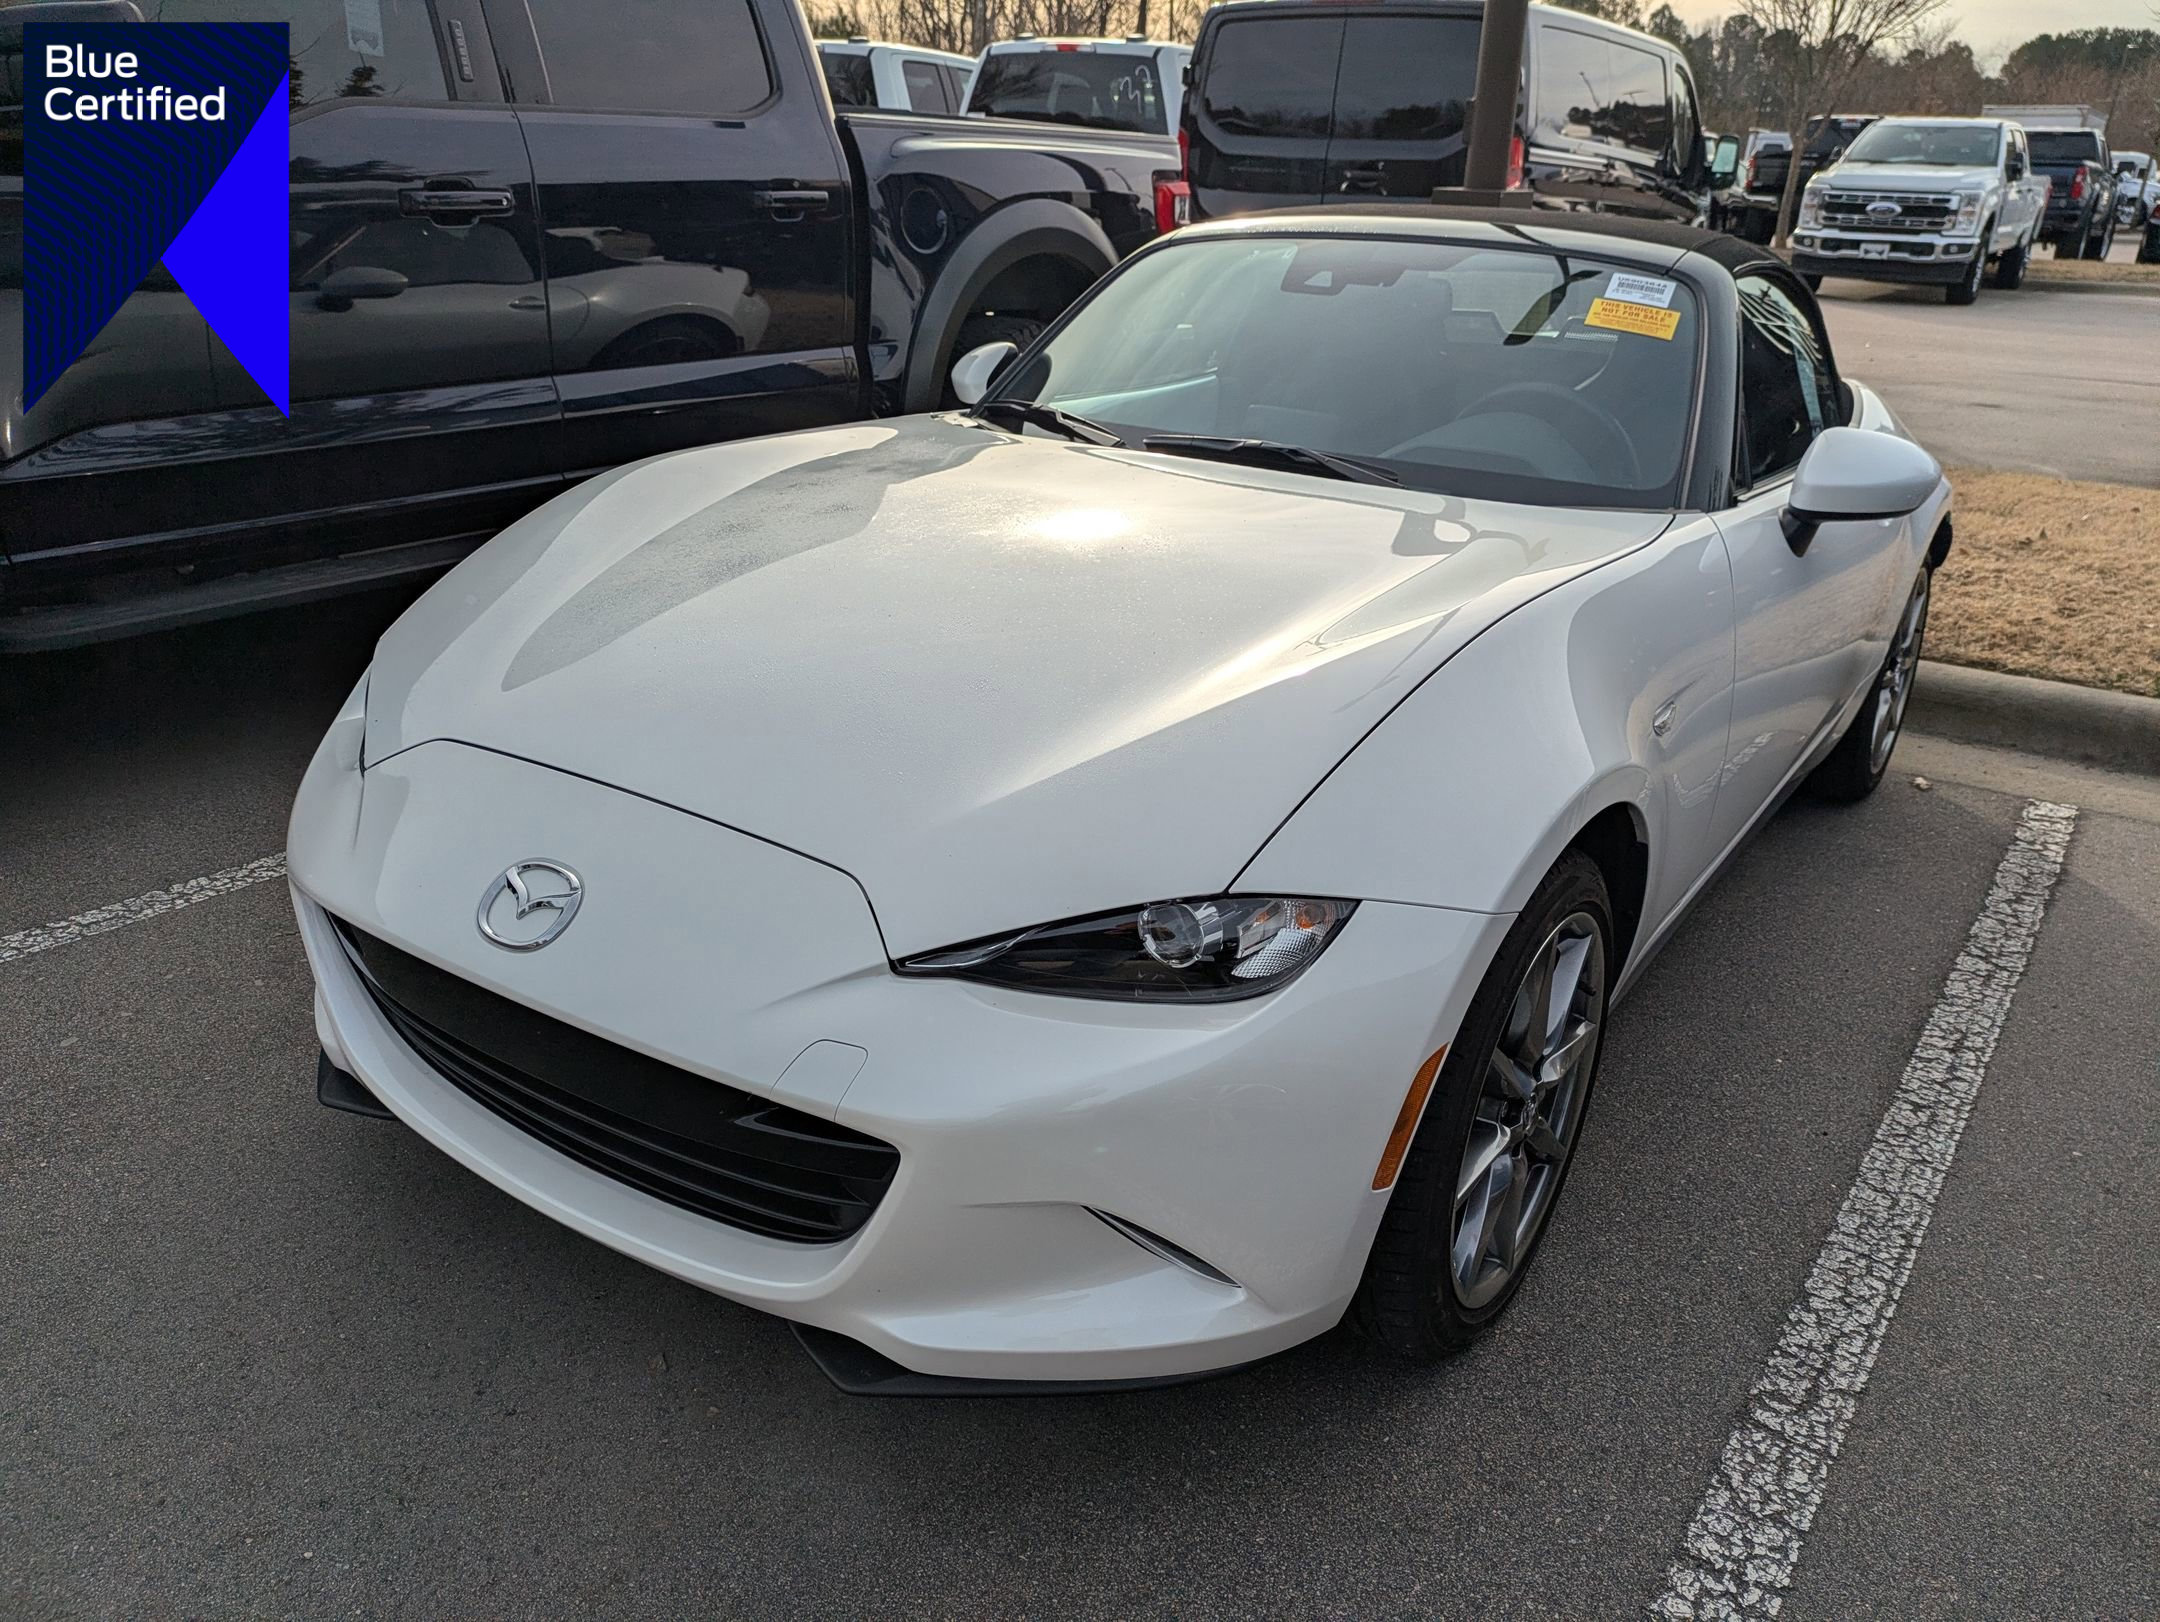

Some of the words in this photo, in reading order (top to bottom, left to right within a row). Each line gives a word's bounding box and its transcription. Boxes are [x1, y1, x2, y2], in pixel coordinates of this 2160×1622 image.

[1623, 304, 1660, 315] VEHICLE
[1622, 310, 1640, 318] FOR
[1643, 314, 1666, 322] SALE
